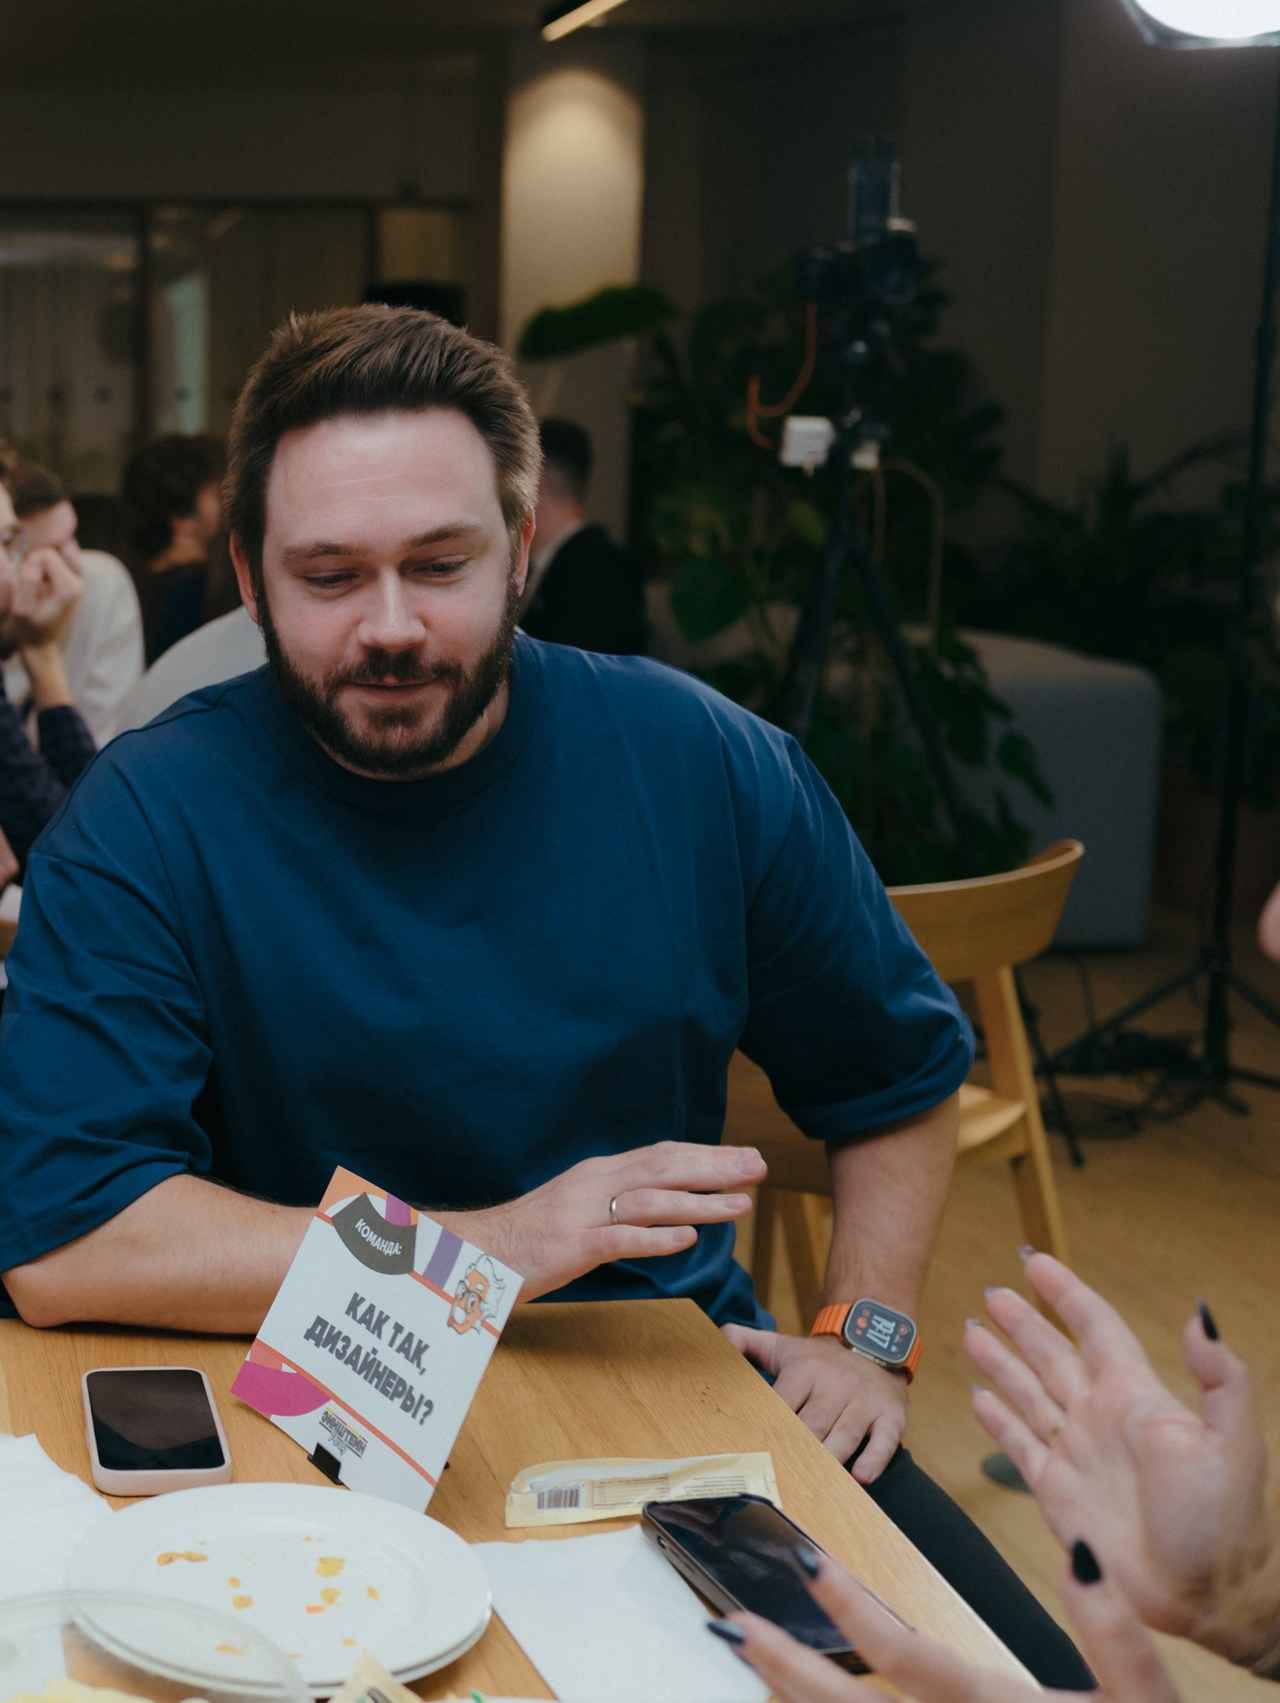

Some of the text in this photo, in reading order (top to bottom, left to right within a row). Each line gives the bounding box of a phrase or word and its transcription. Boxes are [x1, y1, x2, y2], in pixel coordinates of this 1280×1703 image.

[354, 1217, 403, 1257] КОМАНДА:
[344, 1291, 430, 1376] КАК ТАК,
[866, 1314, 897, 1349] 19:17
[303, 1314, 434, 1427] ДИЗАЙНЕРЫ?
